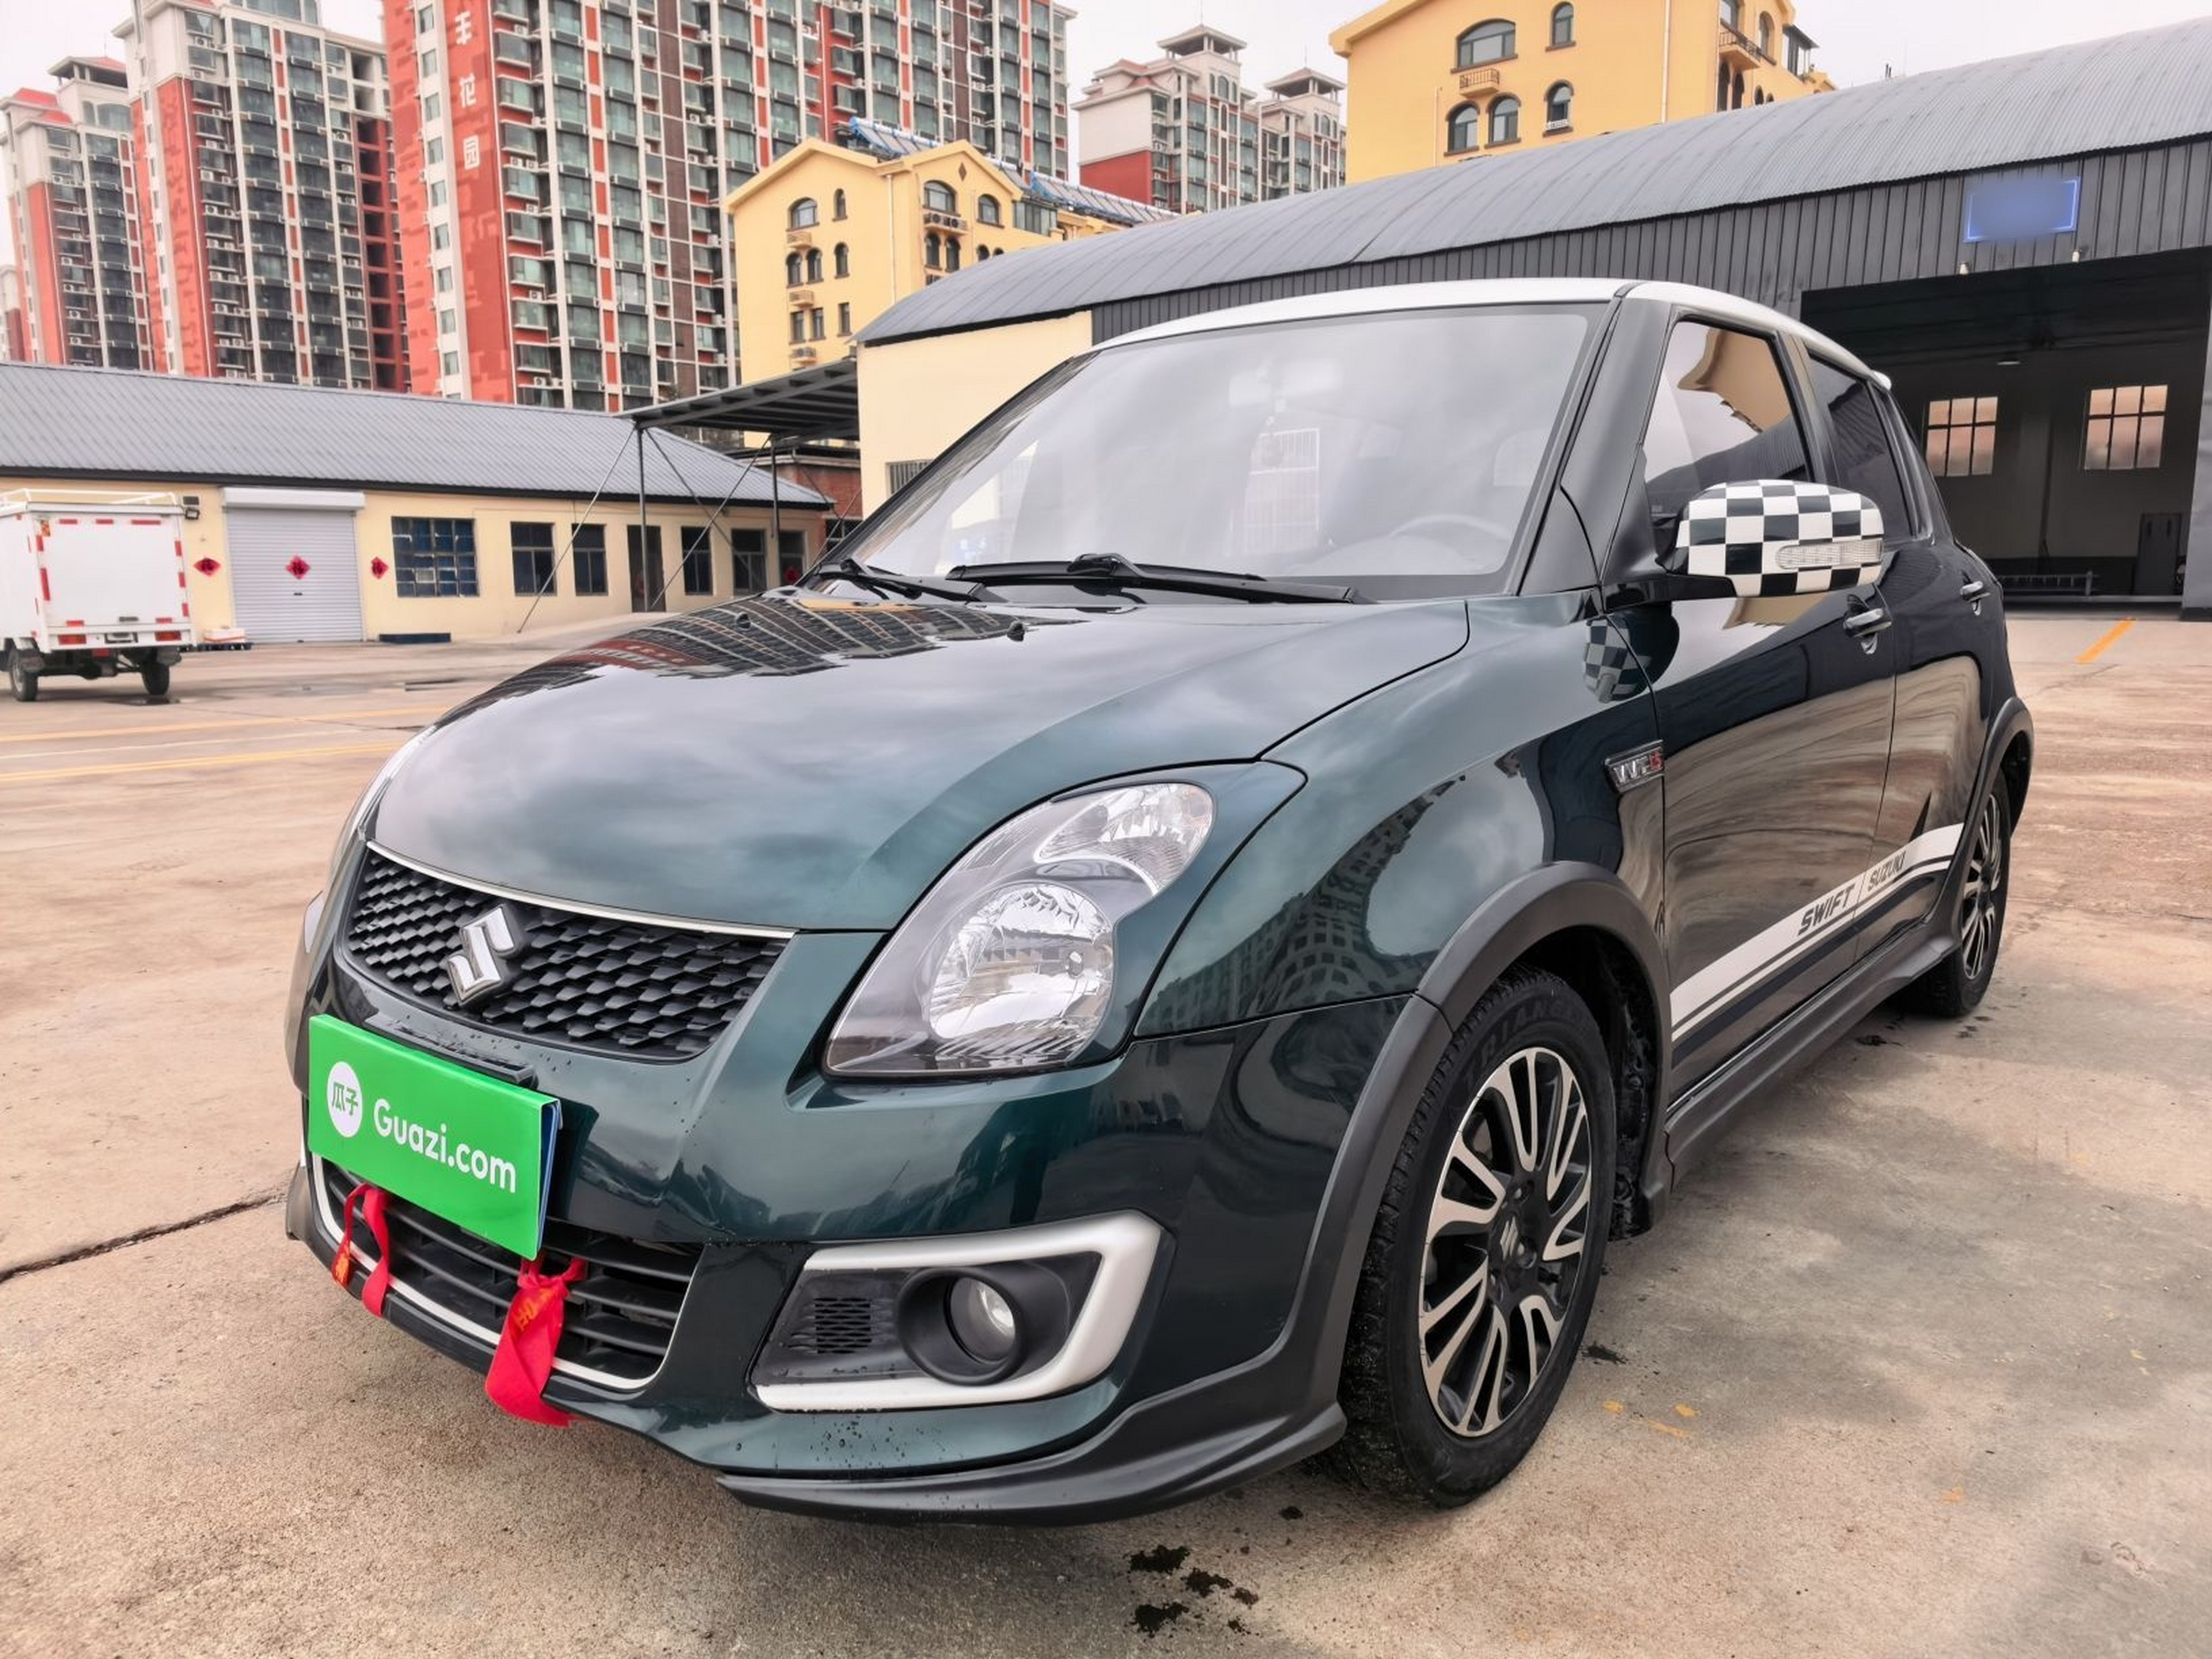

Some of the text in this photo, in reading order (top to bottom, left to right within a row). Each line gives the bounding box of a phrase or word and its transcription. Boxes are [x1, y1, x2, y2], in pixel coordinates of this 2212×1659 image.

[1798, 850, 1906, 935] SWIFT SUZUKI
[332, 1082, 358, 1116] 瓜子
[374, 1098, 516, 1194] Guazi.com
